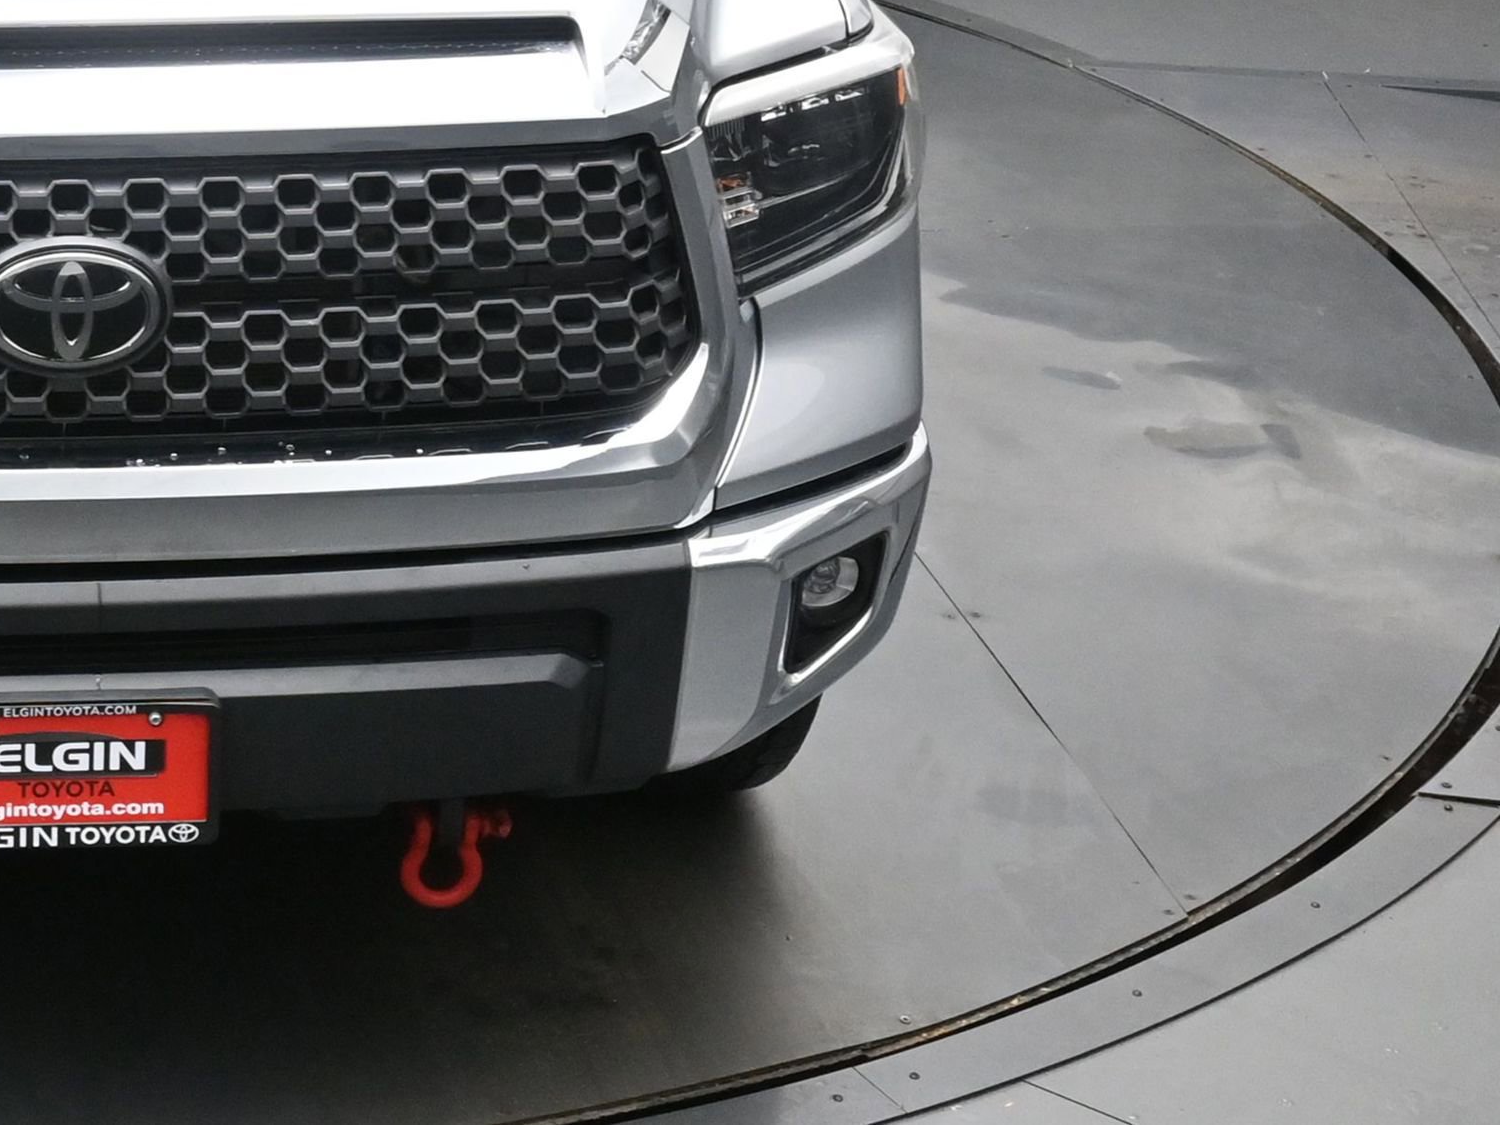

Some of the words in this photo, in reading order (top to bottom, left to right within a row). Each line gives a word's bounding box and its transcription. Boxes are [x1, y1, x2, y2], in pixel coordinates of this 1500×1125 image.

[3, 705, 137, 718] ELGINTOYOTA.COM
[18, 781, 115, 798] TOYOTA
[65, 826, 167, 845] TOYOTA
